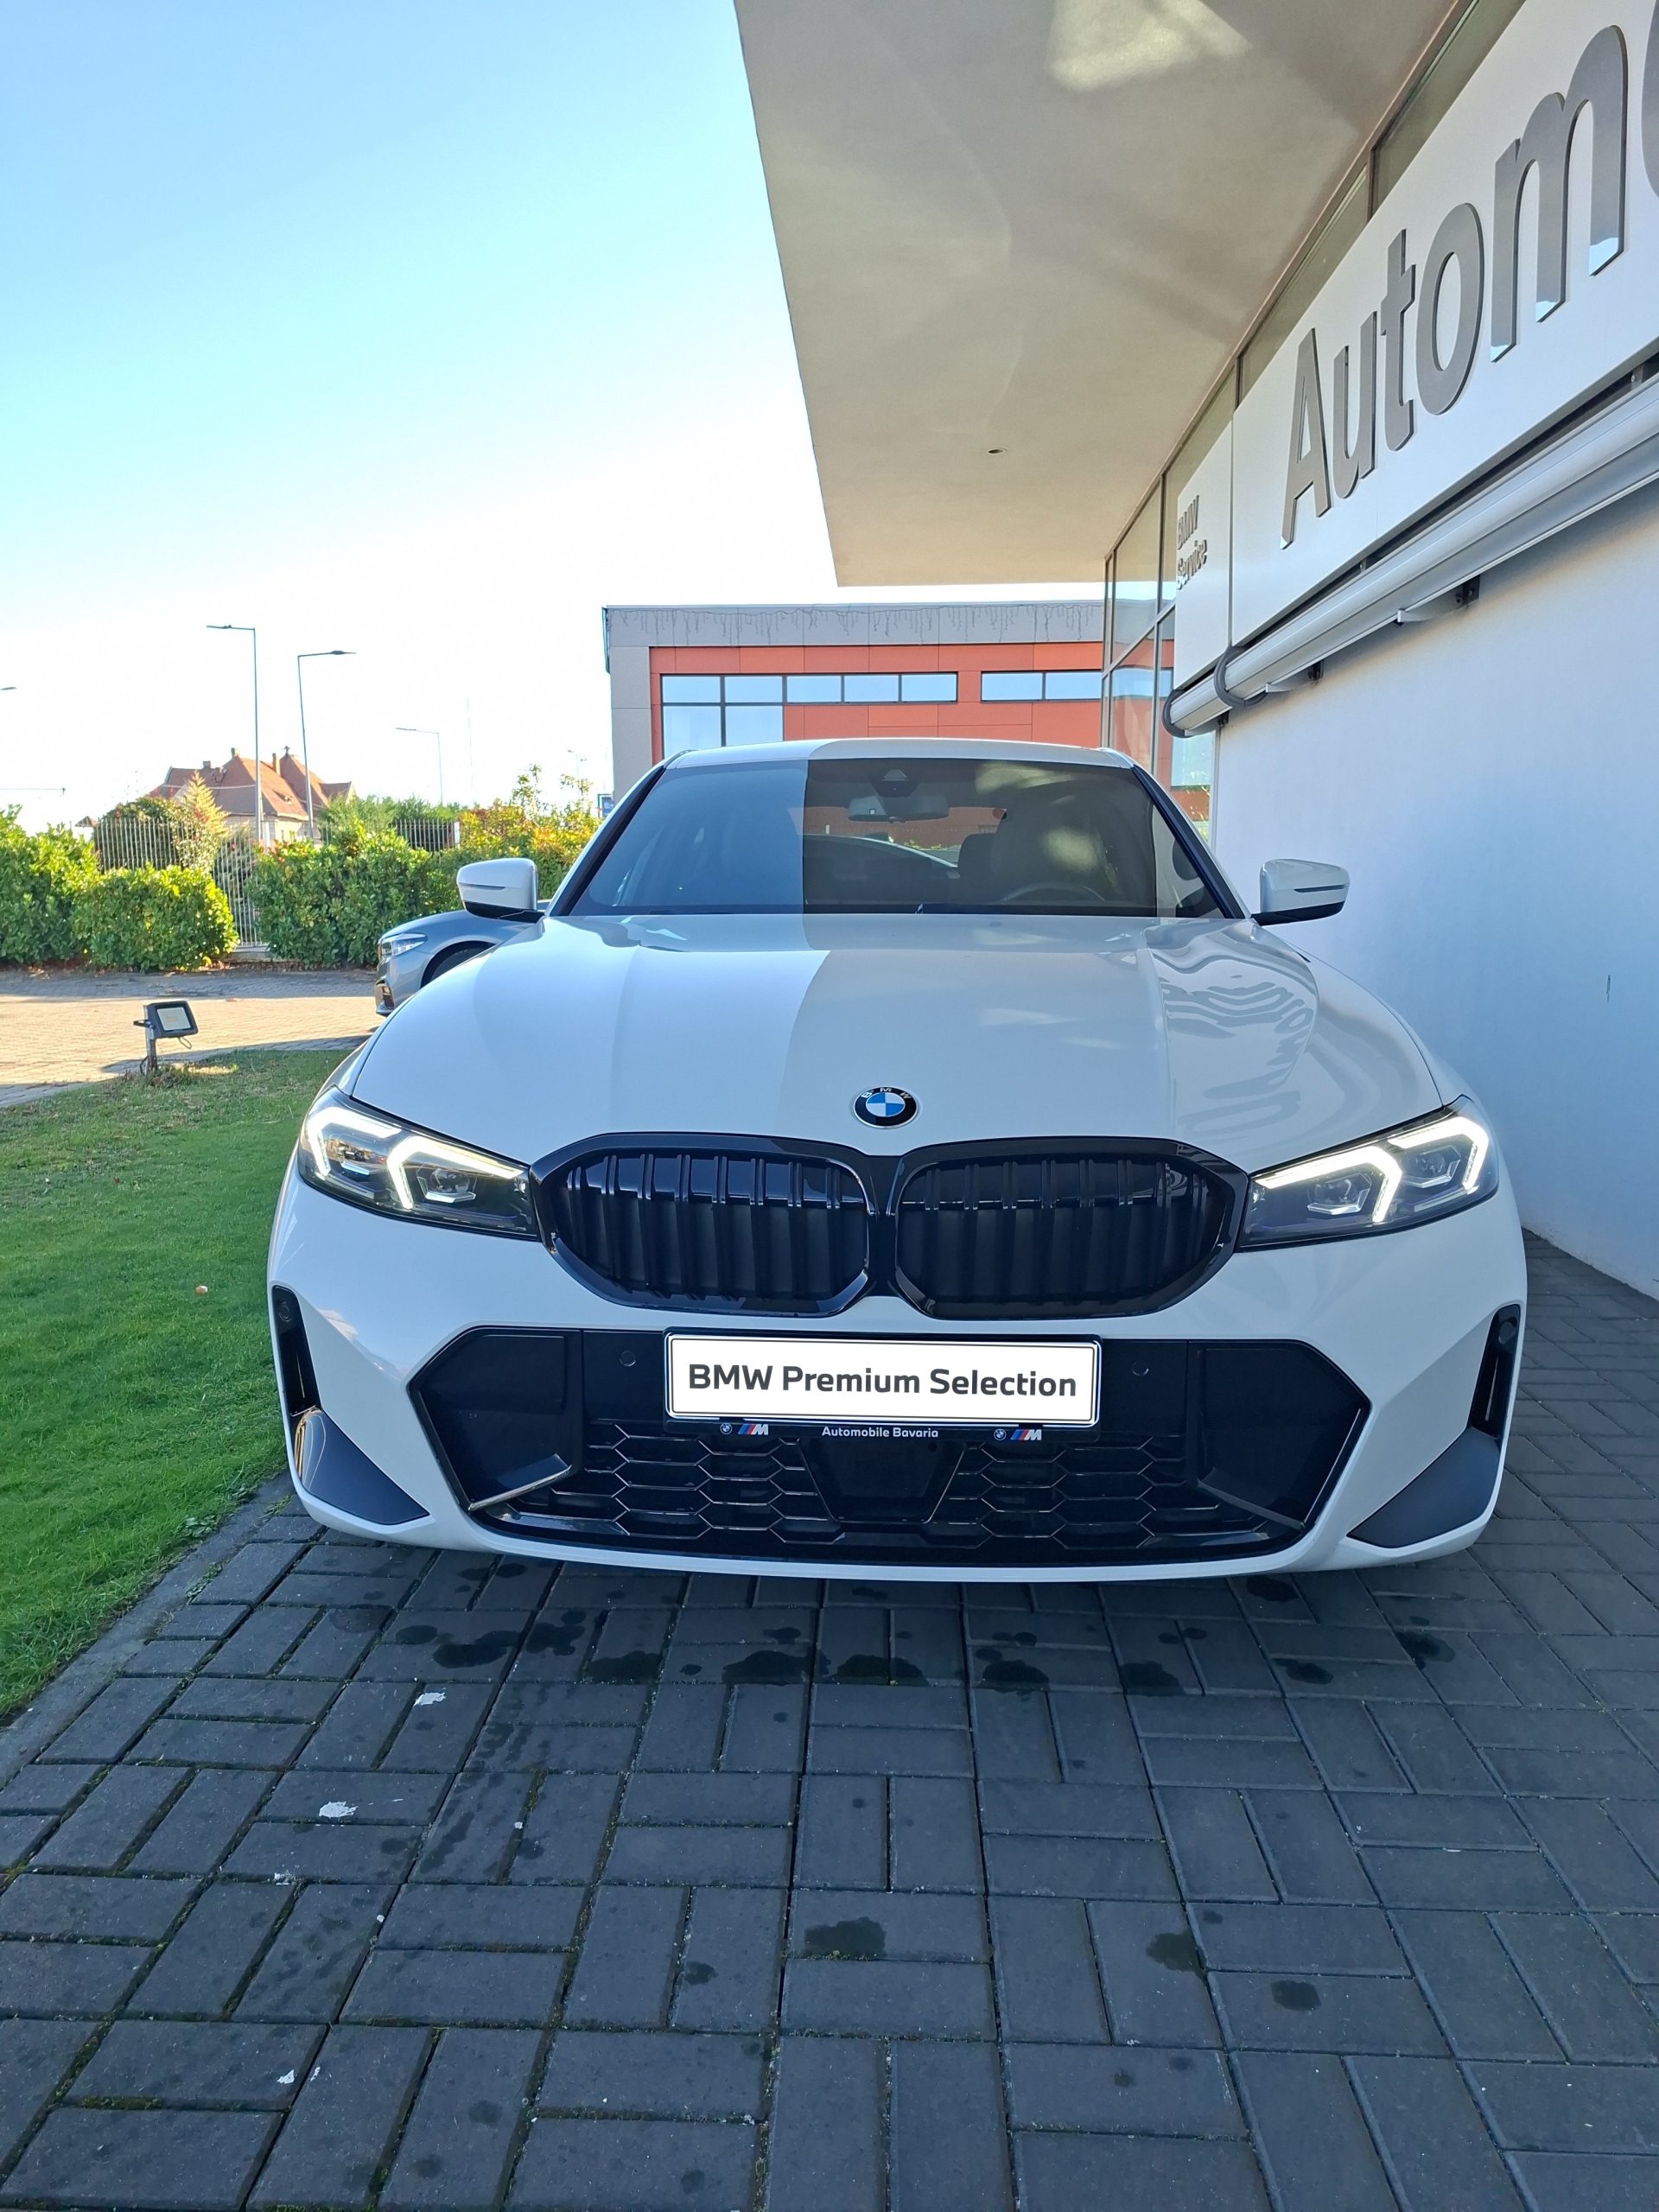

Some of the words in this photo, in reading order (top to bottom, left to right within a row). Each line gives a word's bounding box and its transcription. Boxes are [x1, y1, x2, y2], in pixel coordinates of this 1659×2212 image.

[1281, 0, 1659, 550] Autom
[1176, 539, 1208, 591] Service
[861, 1087, 912, 1099] BMW
[689, 1363, 773, 1390] BMW
[783, 1365, 920, 1394] Premium
[930, 1368, 1077, 1397] Selection
[822, 1426, 890, 1438] Automobile
[893, 1427, 939, 1438] Bavaria
